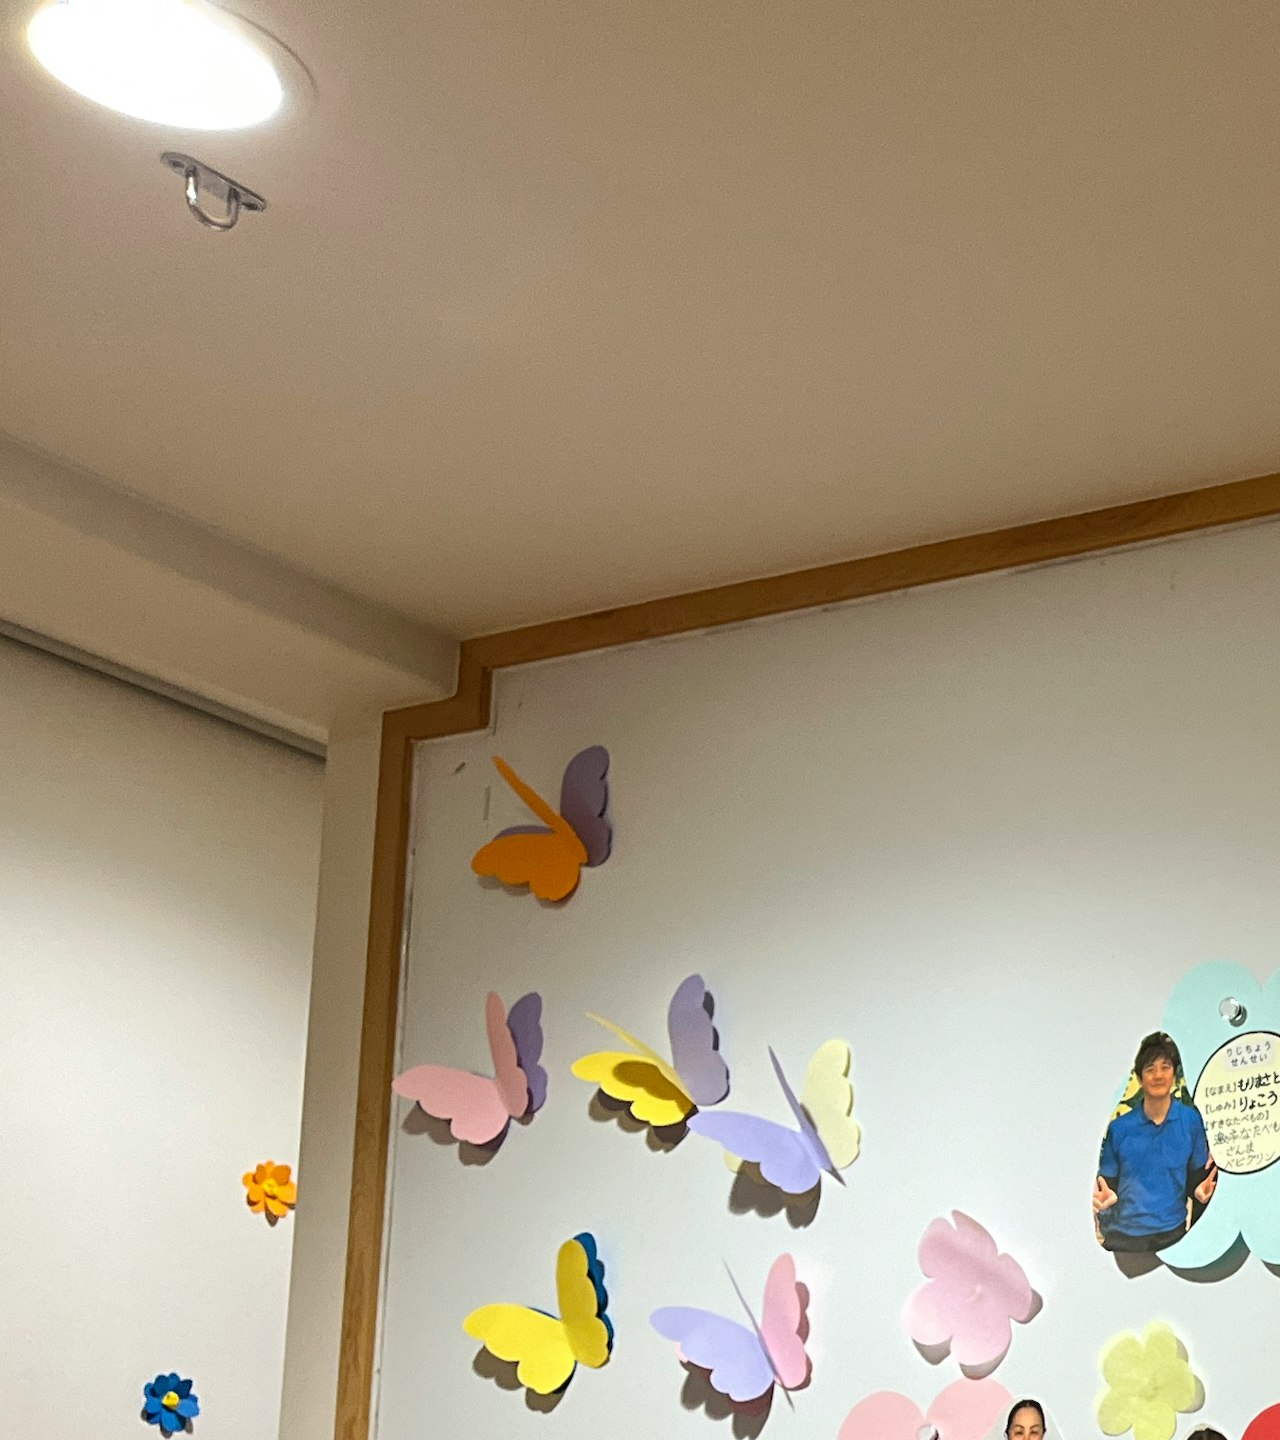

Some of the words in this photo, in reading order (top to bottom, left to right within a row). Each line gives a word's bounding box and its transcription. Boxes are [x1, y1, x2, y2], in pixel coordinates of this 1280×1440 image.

[1226, 1041, 1271, 1057] りじちょう
[1231, 1054, 1267, 1067] せんせい
[1240, 1091, 1278, 1113] りょこう
